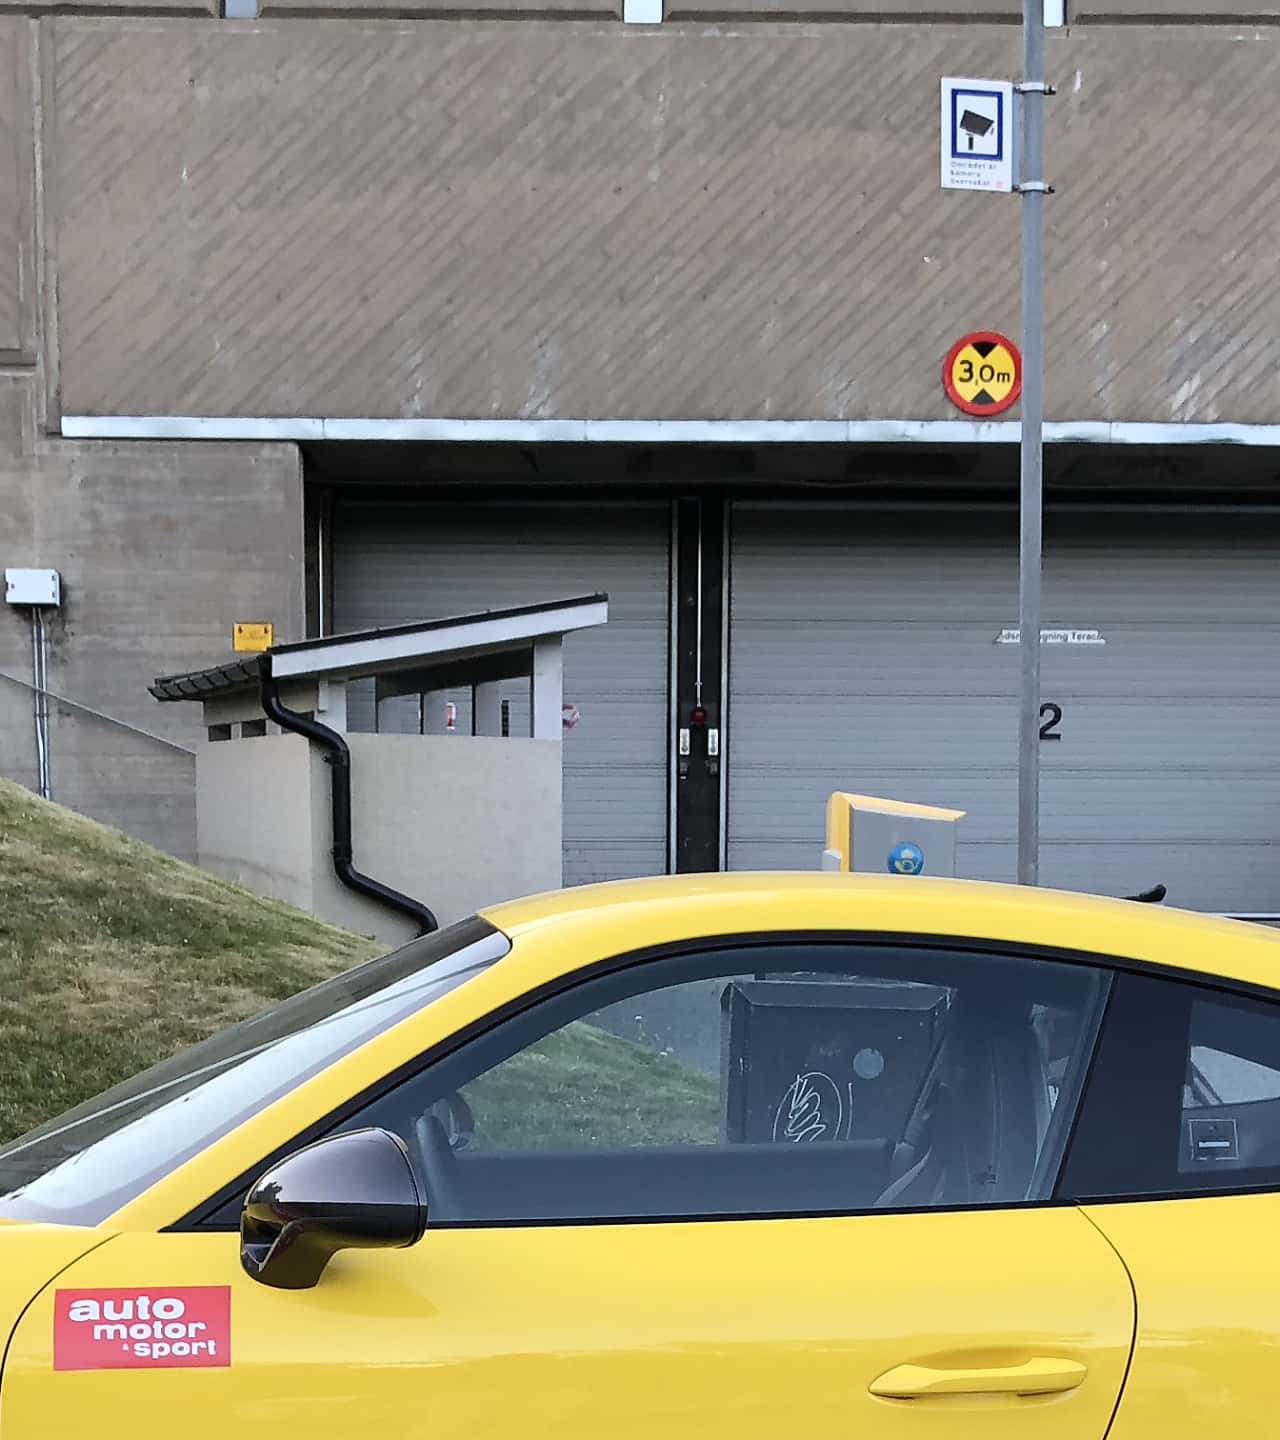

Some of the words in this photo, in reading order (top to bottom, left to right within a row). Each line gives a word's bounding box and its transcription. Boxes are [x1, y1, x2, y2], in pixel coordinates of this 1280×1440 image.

[69, 1296, 185, 1322] auto
[93, 1320, 207, 1340] motor
[133, 1339, 216, 1359] sport
